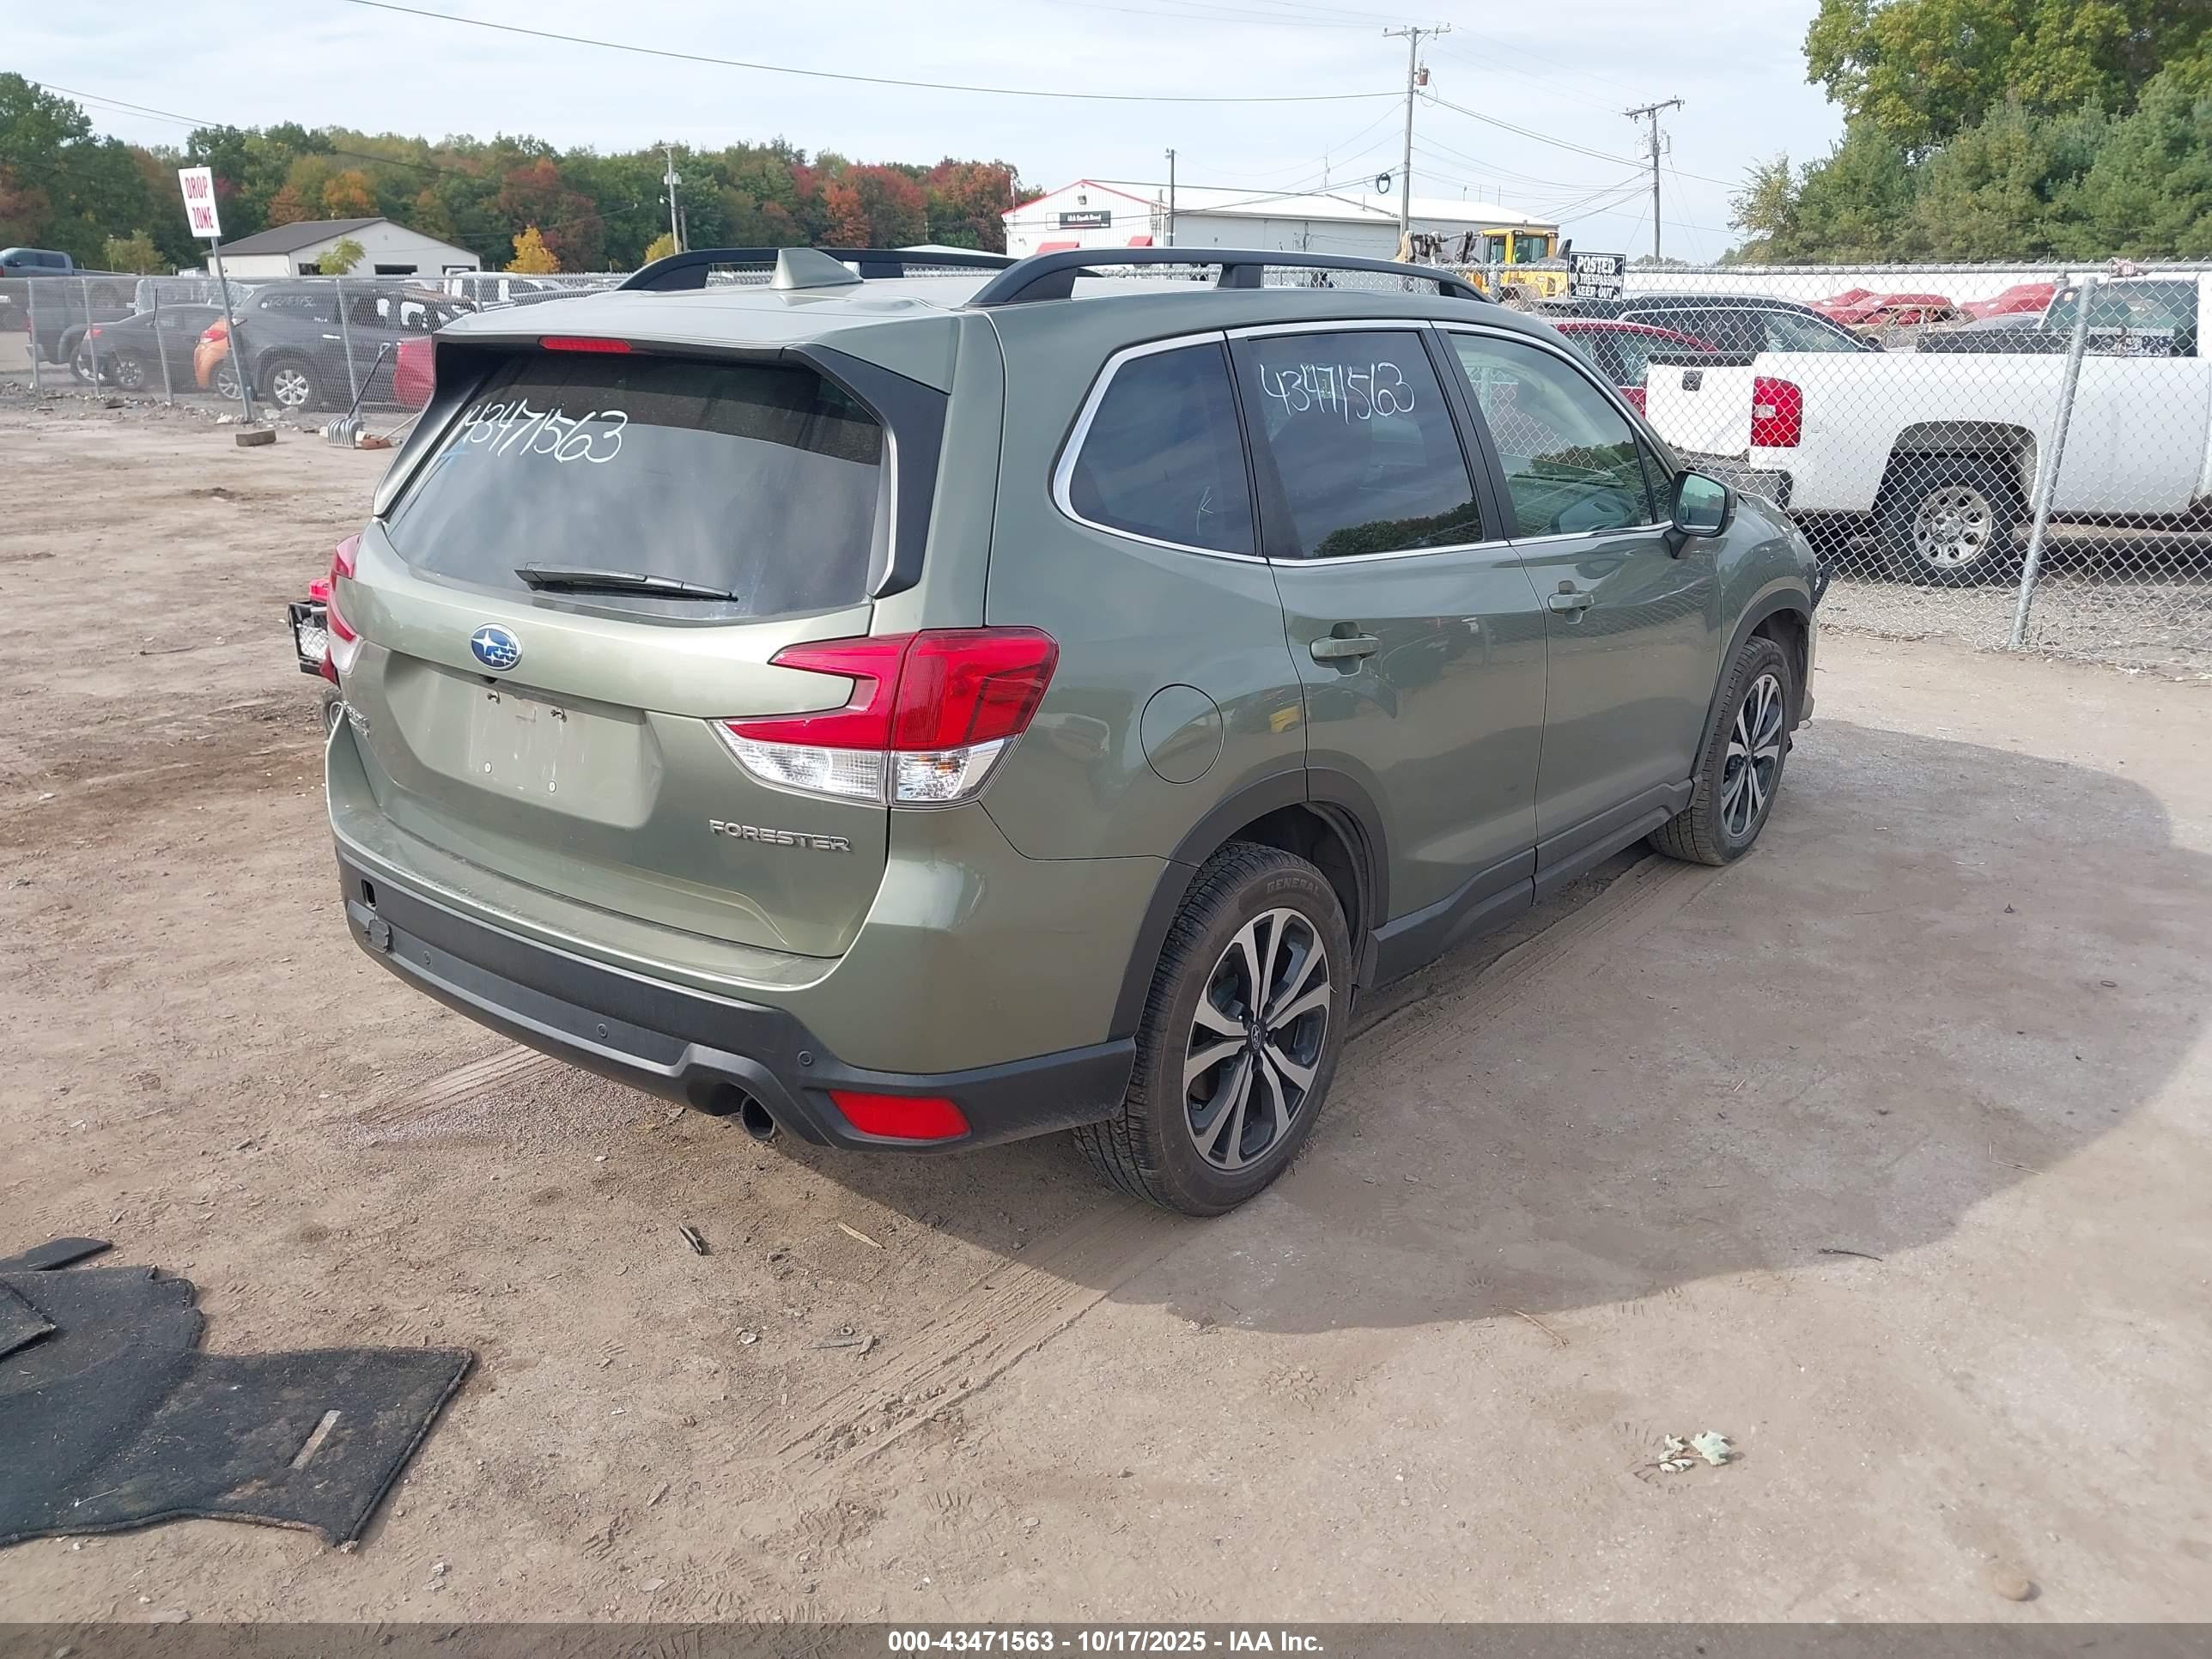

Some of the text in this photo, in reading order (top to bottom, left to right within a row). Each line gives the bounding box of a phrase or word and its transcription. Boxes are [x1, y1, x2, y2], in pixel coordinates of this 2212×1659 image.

[185, 176, 208, 199] DROP
[191, 206, 214, 229] ZONE
[1577, 256, 1616, 275] POSTED
[1576, 285, 1613, 299] KEEP OUT
[1580, 273, 1622, 288] TRESPASSING
[1260, 362, 1415, 426] 43471563
[462, 398, 629, 464] 43471563
[709, 819, 852, 852] FORESTER
[1267, 877, 1320, 898] GENERAL
